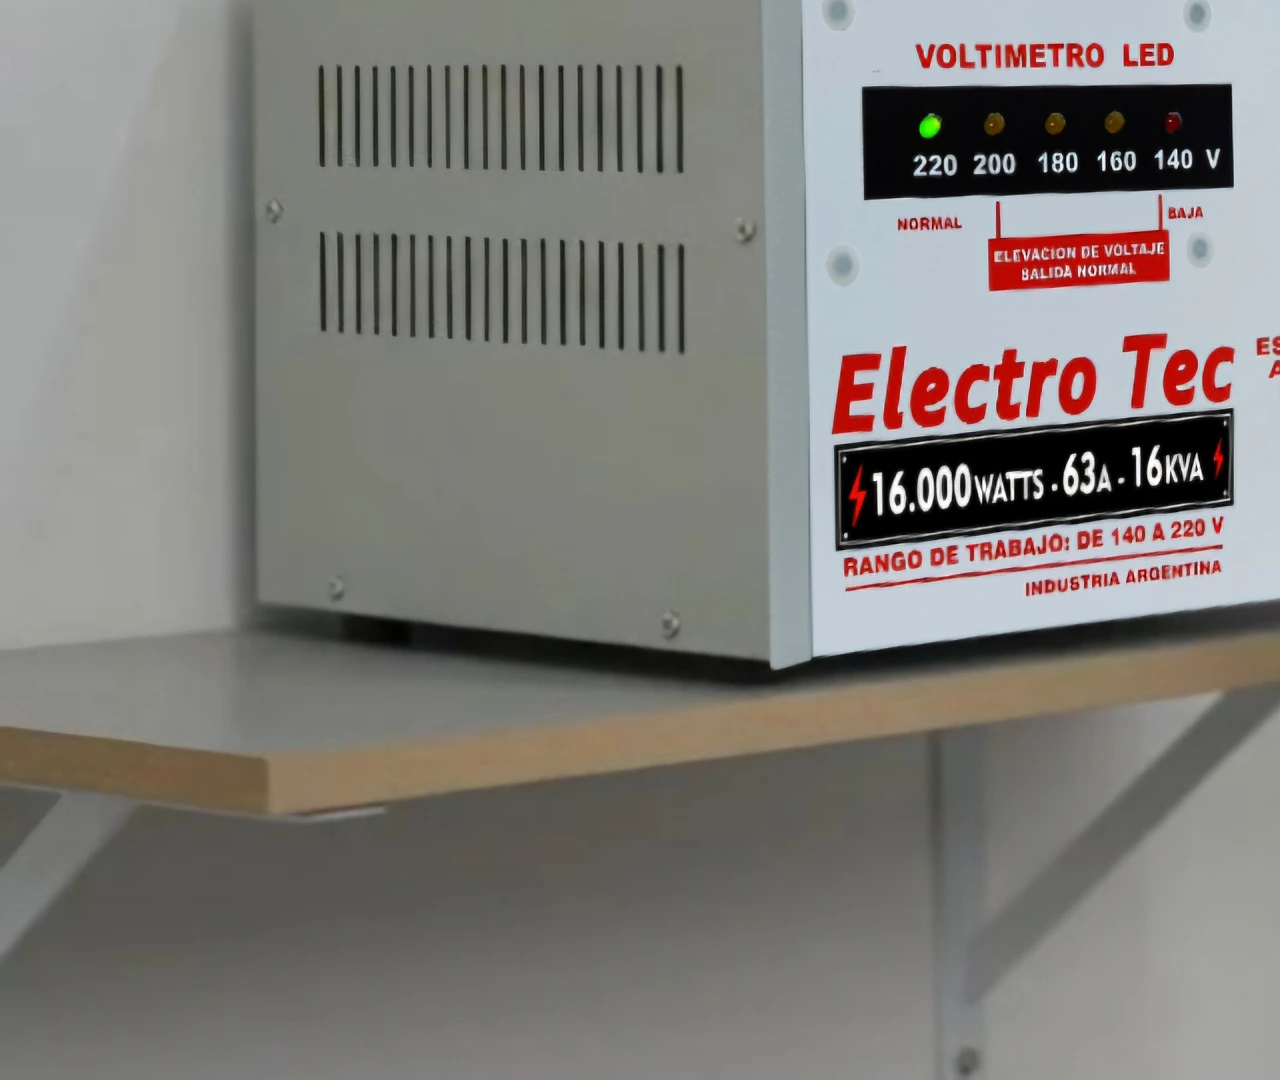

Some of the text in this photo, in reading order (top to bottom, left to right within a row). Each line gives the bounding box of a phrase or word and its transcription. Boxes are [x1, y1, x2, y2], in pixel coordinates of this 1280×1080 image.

[916, 42, 1175, 69] VOLTIMETRO LED
[913, 148, 1221, 176] 220 200 180 160 140 V
[897, 216, 963, 231] NORMAL
[1168, 206, 1204, 220] BAJA
[994, 241, 1165, 263] ELEVACION DE VOLTAJE
[1021, 261, 1137, 281] SALIDA NORMAL
[831, 333, 1235, 435] Electro Tec
[1062, 451, 1112, 497] 63A
[1131, 445, 1204, 488] 16KVA
[843, 516, 1225, 577] RANGO DE TRABAJO: DE 140 A 220 V
[1025, 559, 1222, 597] INDUSTRIA ARGENTINA
